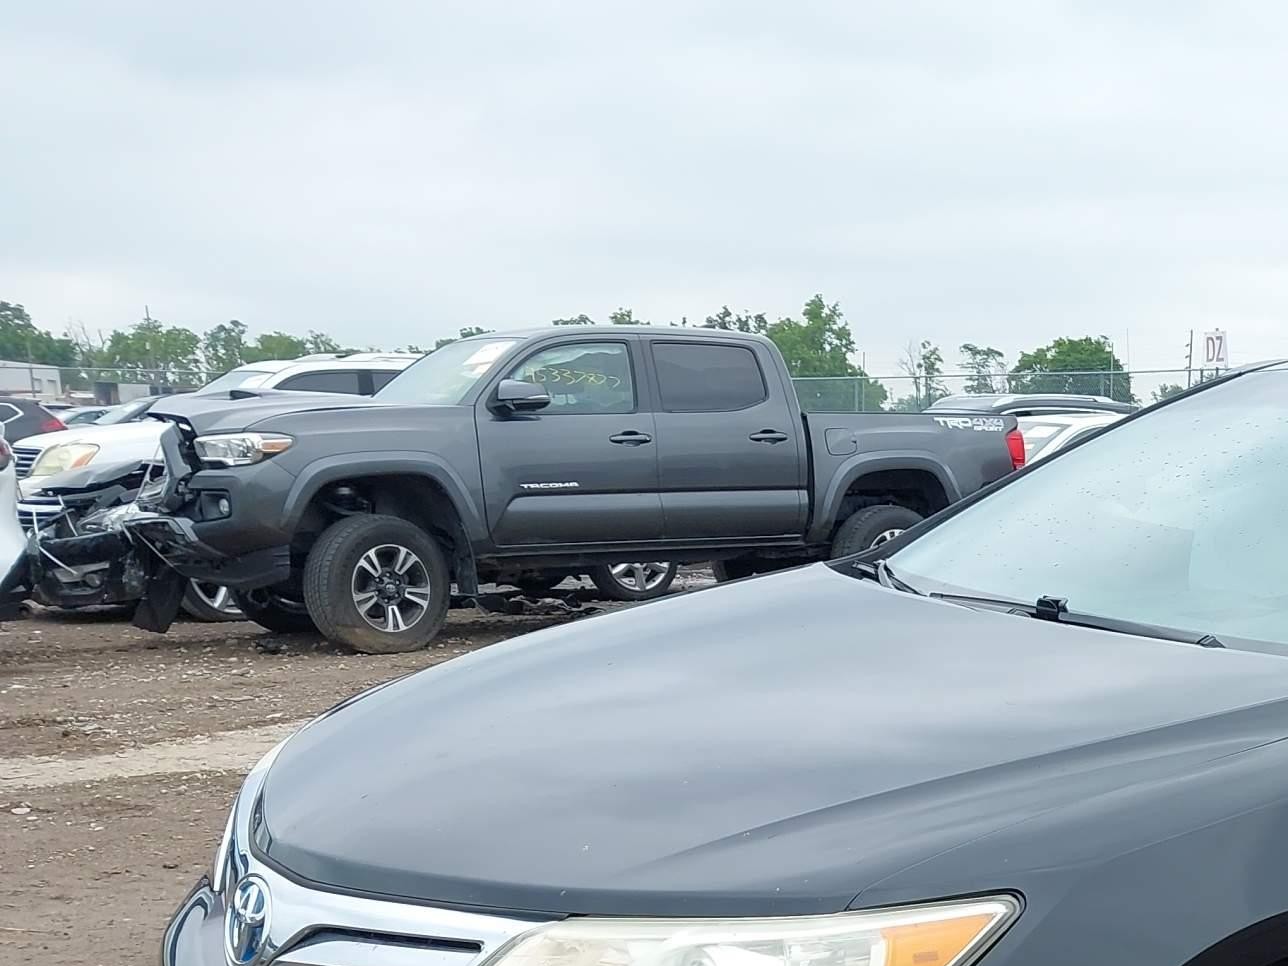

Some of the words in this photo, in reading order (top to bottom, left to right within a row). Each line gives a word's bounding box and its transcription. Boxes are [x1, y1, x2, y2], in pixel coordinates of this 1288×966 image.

[1205, 335, 1225, 363] DZ
[933, 416, 973, 430] TRD
[519, 481, 581, 490] TACOMA
